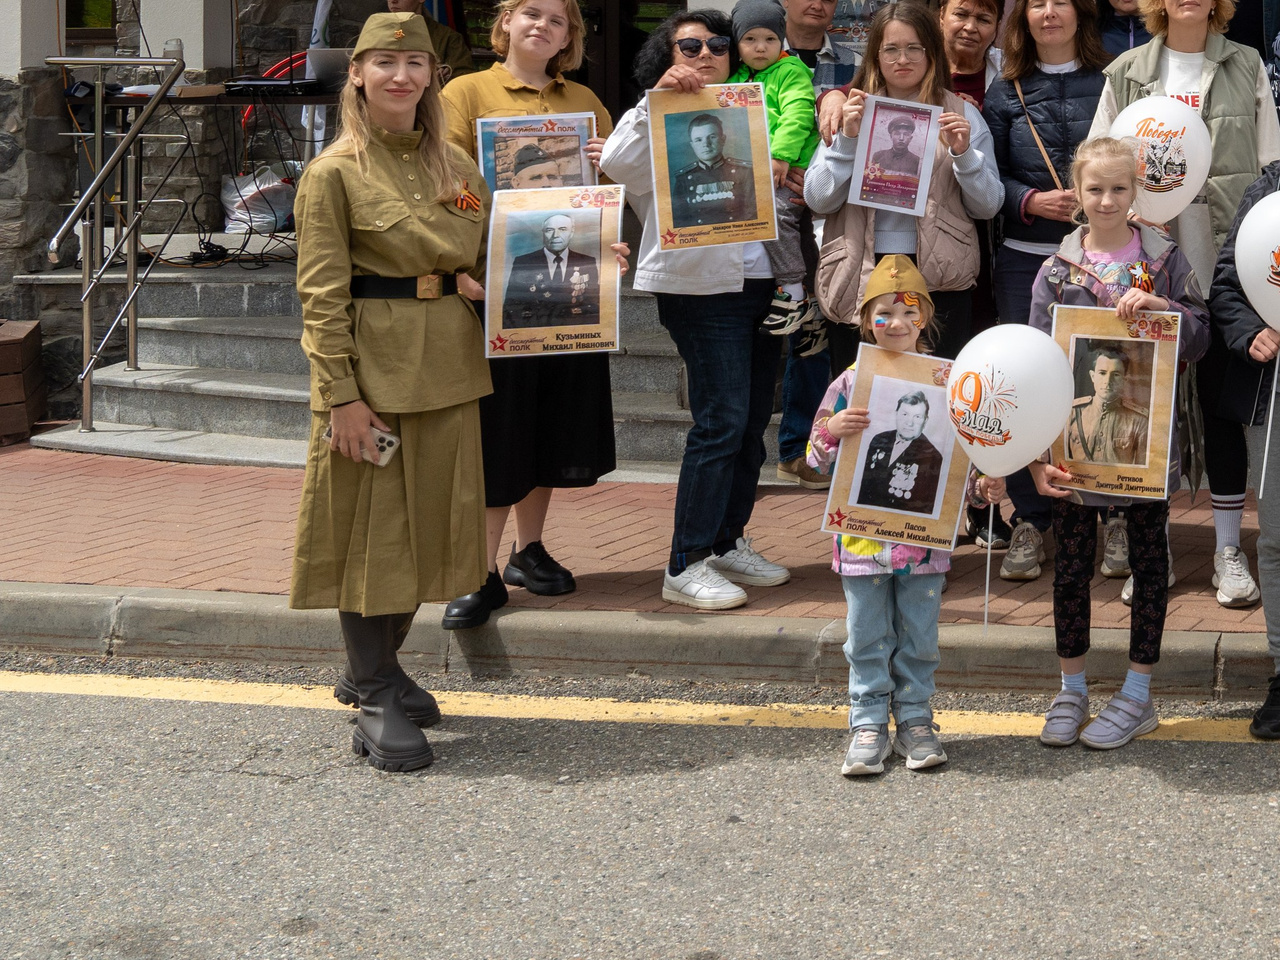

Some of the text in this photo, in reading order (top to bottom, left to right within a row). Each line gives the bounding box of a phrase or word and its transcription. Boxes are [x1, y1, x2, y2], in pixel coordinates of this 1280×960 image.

[738, 91, 749, 107] 9
[1136, 118, 1187, 143] Победа!
[594, 193, 605, 208] 9
[555, 332, 601, 342] Кузьминых
[1151, 321, 1162, 340] 9
[543, 341, 615, 351] Михаил Иванович
[957, 371, 983, 413] 9
[960, 409, 1003, 435] мая
[1117, 474, 1144, 483] Ретивов
[1095, 481, 1165, 493] Дмитрий Дмитриевич
[846, 523, 867, 533] ПОЛК
[904, 522, 927, 533] Пасов
[874, 527, 952, 546] Алексей Михайлович
